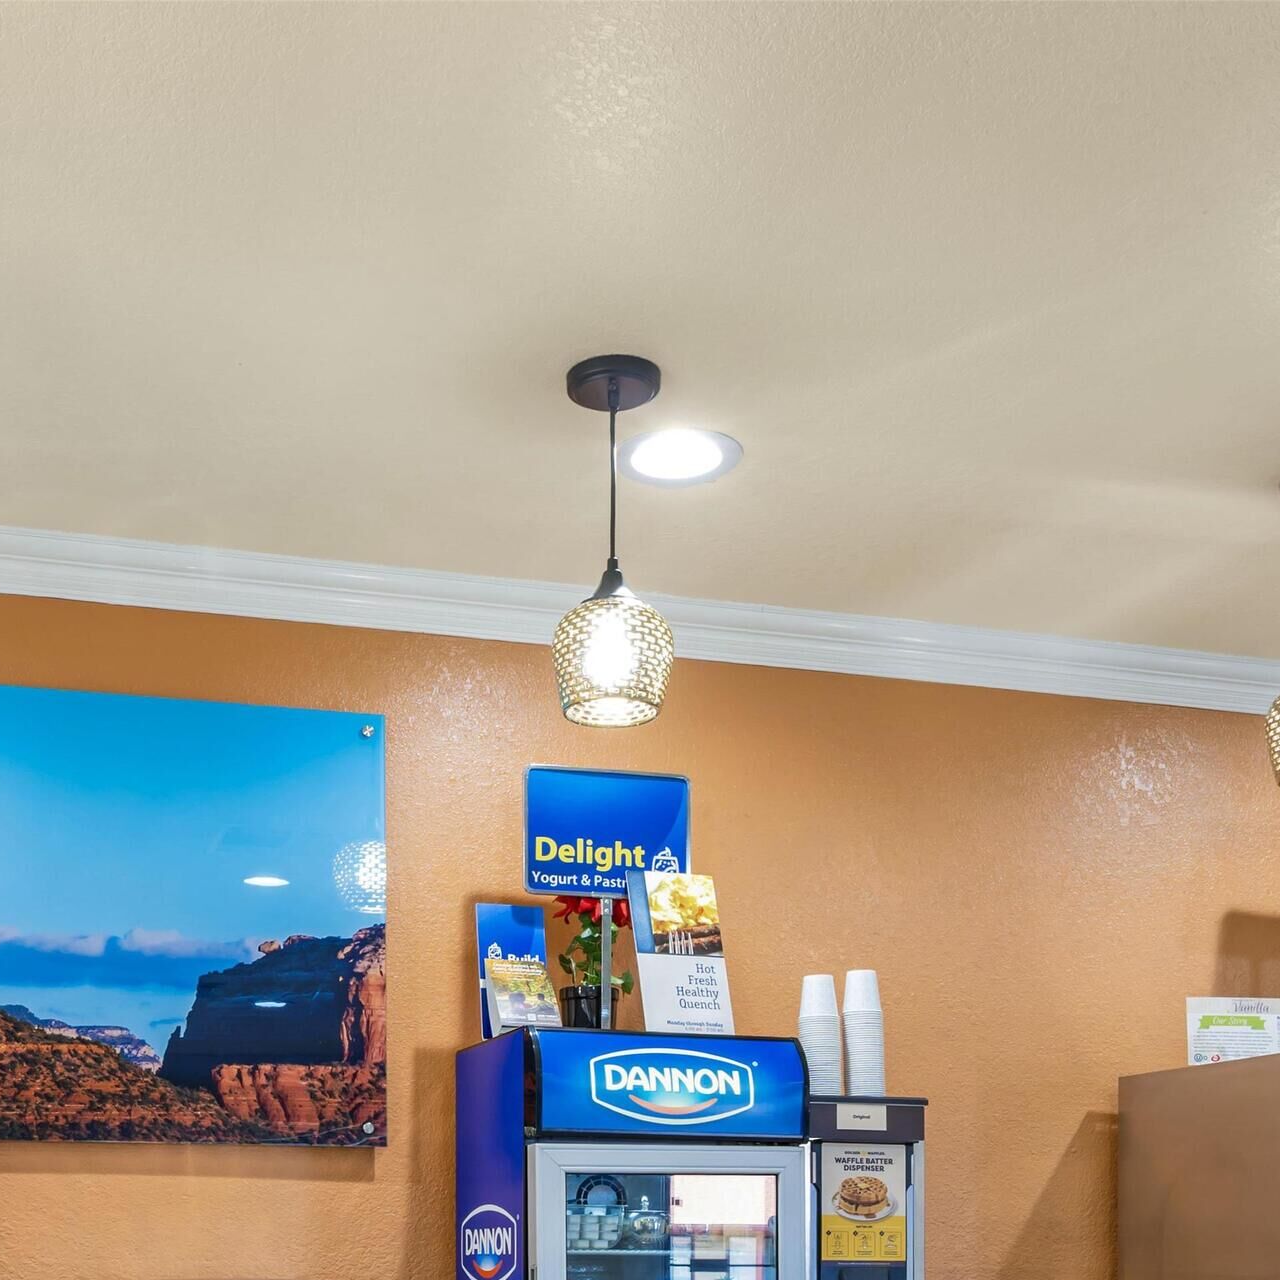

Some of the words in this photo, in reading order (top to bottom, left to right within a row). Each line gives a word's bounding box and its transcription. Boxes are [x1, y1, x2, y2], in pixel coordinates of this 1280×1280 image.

[535, 836, 646, 872] Delight
[531, 870, 577, 887] Yogurt
[580, 874, 591, 887] &
[594, 876, 627, 888] Pastr
[695, 963, 716, 974] Hot
[688, 974, 718, 987] Fresh
[676, 986, 719, 1000] Healthy
[679, 998, 721, 1011] Quench
[1233, 1001, 1271, 1014] Vanilla
[604, 1064, 741, 1095] DANNON
[834, 1157, 864, 1165] WAFFLE
[865, 1157, 894, 1165] BATTER
[843, 1164, 885, 1172] DISPENSER
[465, 1227, 512, 1256] DANNON
